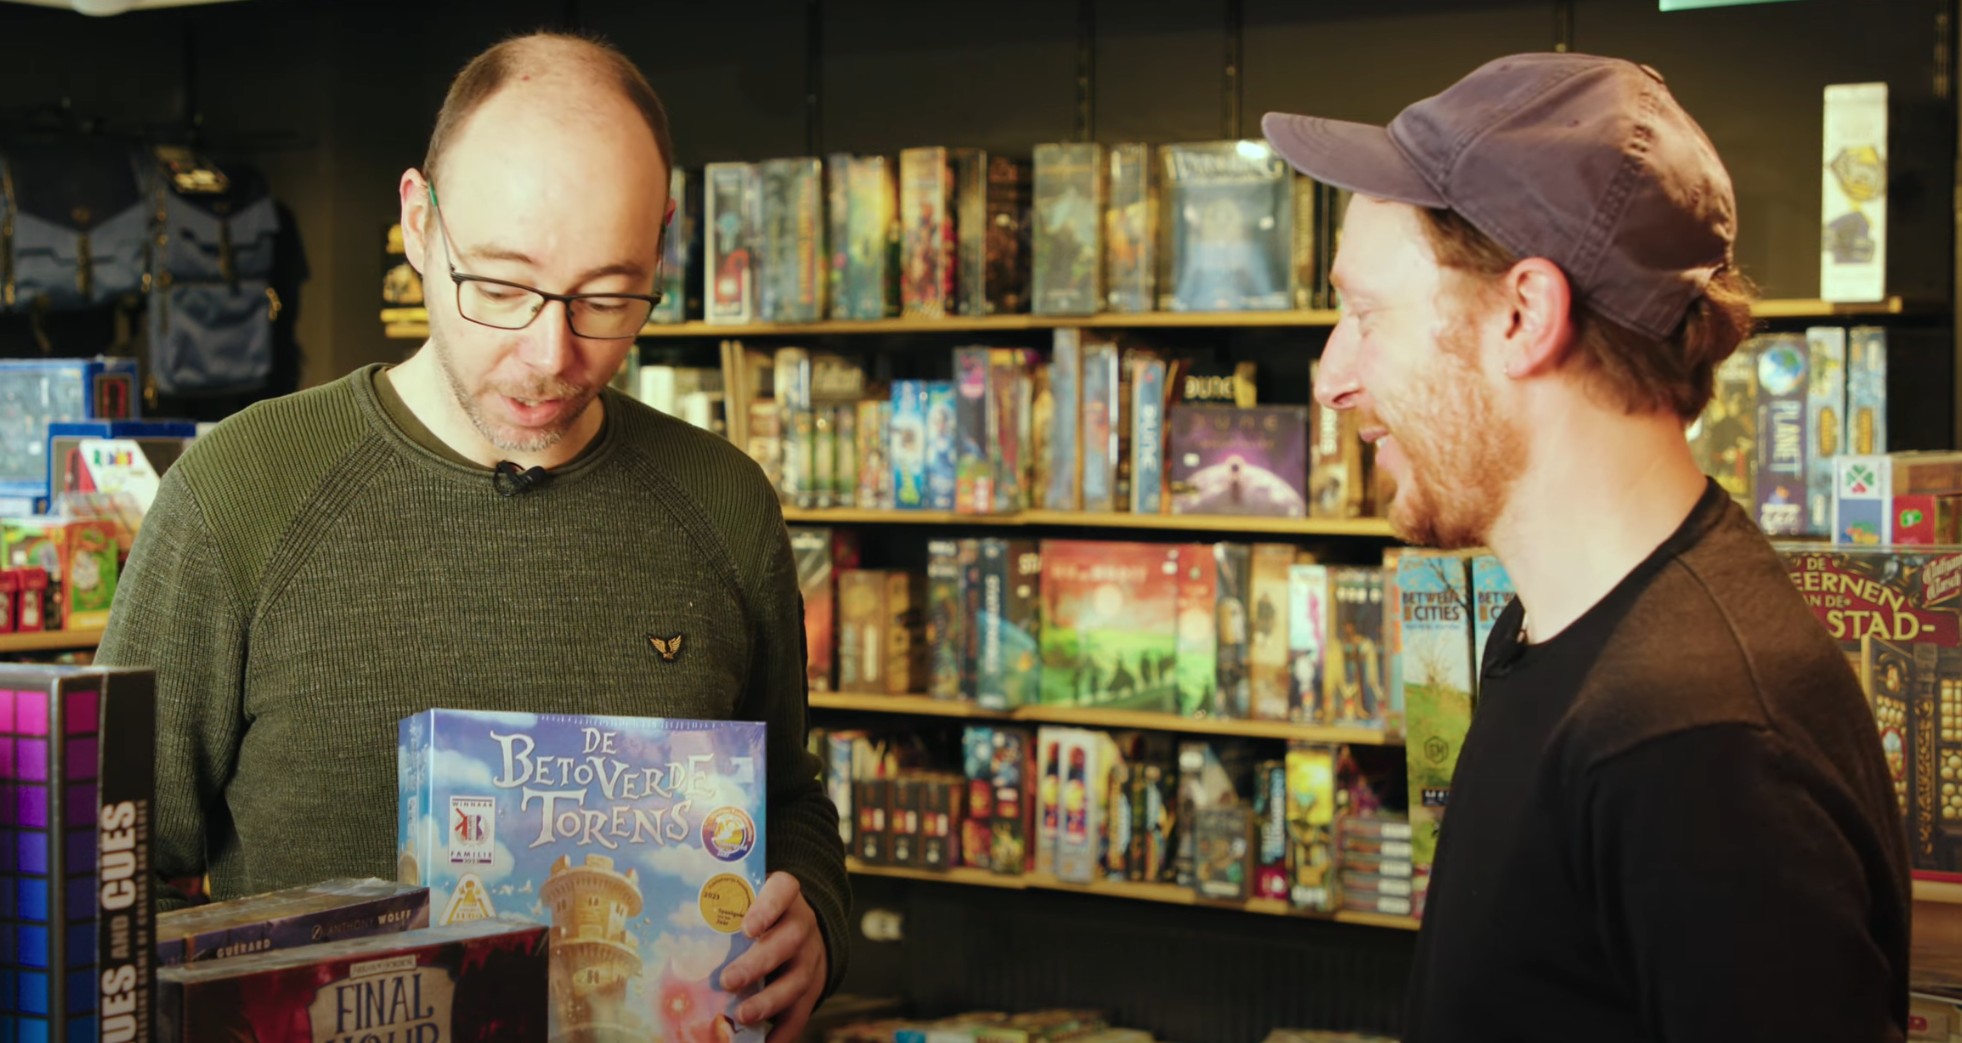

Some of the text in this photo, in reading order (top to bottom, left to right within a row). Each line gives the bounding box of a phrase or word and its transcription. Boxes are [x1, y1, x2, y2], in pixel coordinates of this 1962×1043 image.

[1768, 400, 1802, 480] PLANET
[1807, 557, 1827, 571] DE
[1789, 571, 1906, 613] EERNEN
[1414, 605, 1460, 621] CITIES
[581, 727, 617, 755] DE
[101, 801, 137, 1043] UES AND CUES
[328, 909, 412, 937] ANTHONY WOLFF
[335, 973, 434, 1034] FINAL
